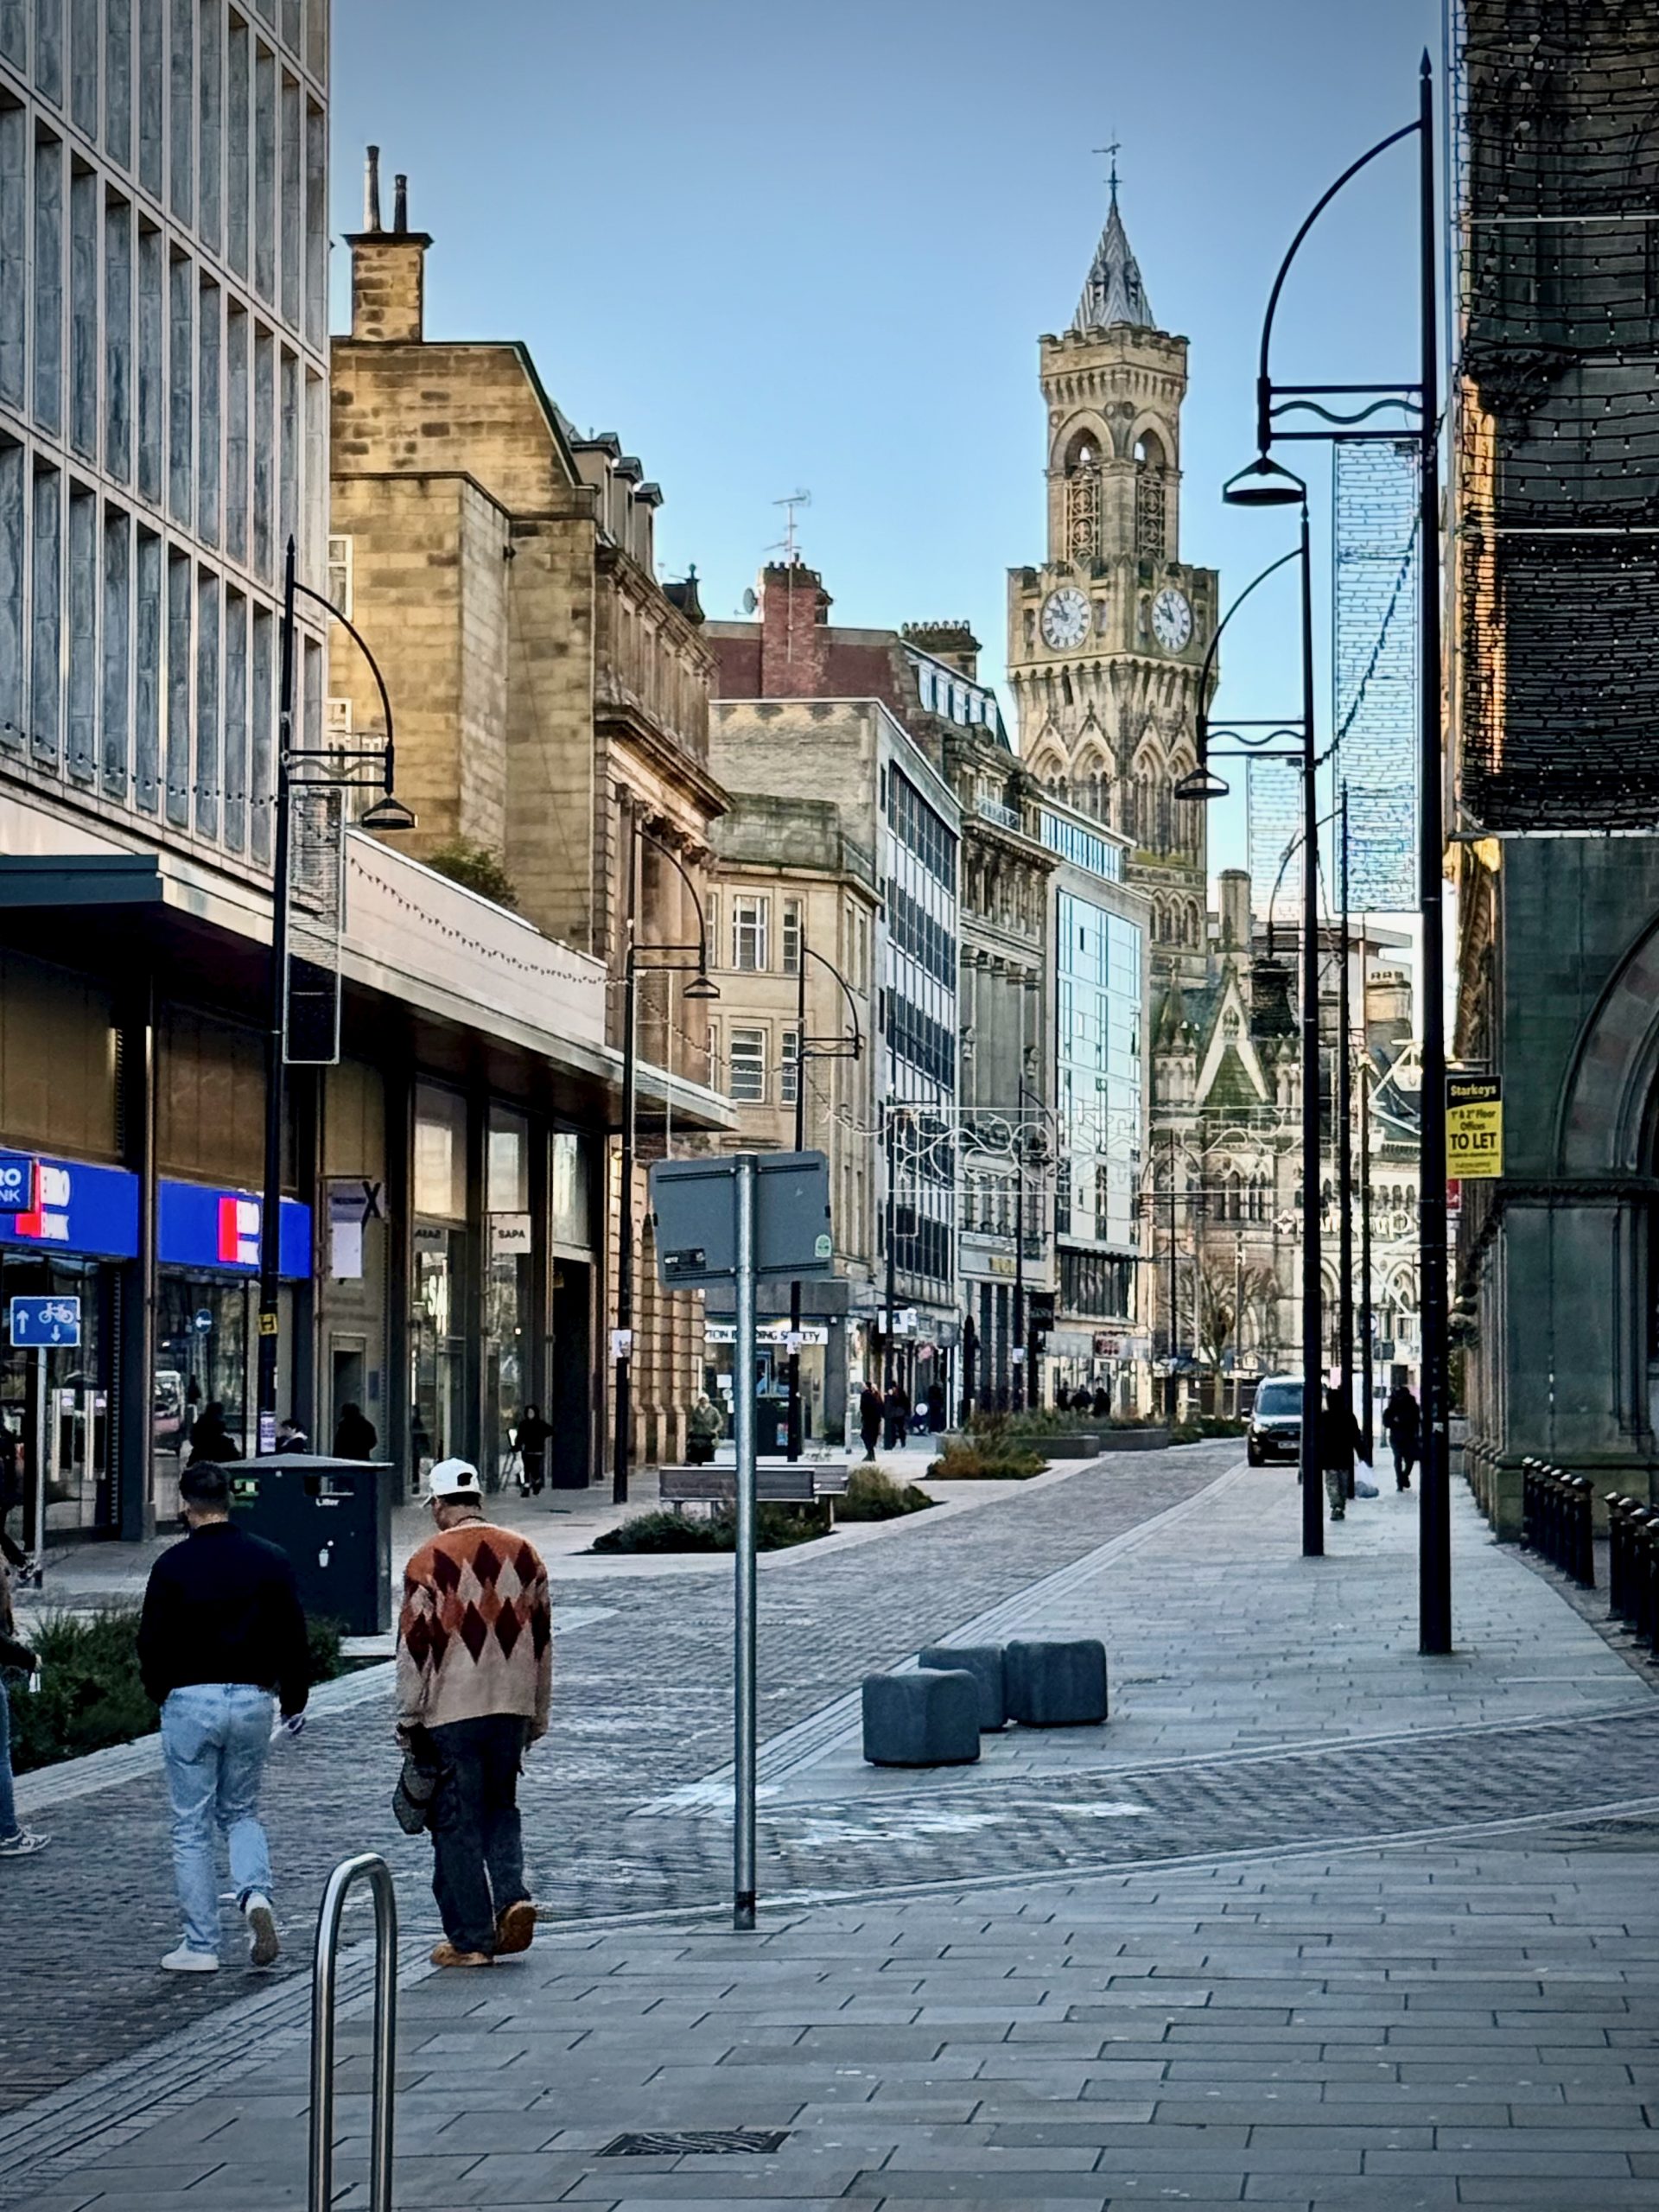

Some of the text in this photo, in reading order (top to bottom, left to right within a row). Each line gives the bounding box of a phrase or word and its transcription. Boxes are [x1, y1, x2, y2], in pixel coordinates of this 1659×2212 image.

[1451, 1084, 1497, 1097] Starkeys
[1450, 1132, 1497, 1149] TO LET
[498, 1230, 525, 1239] SAPA
